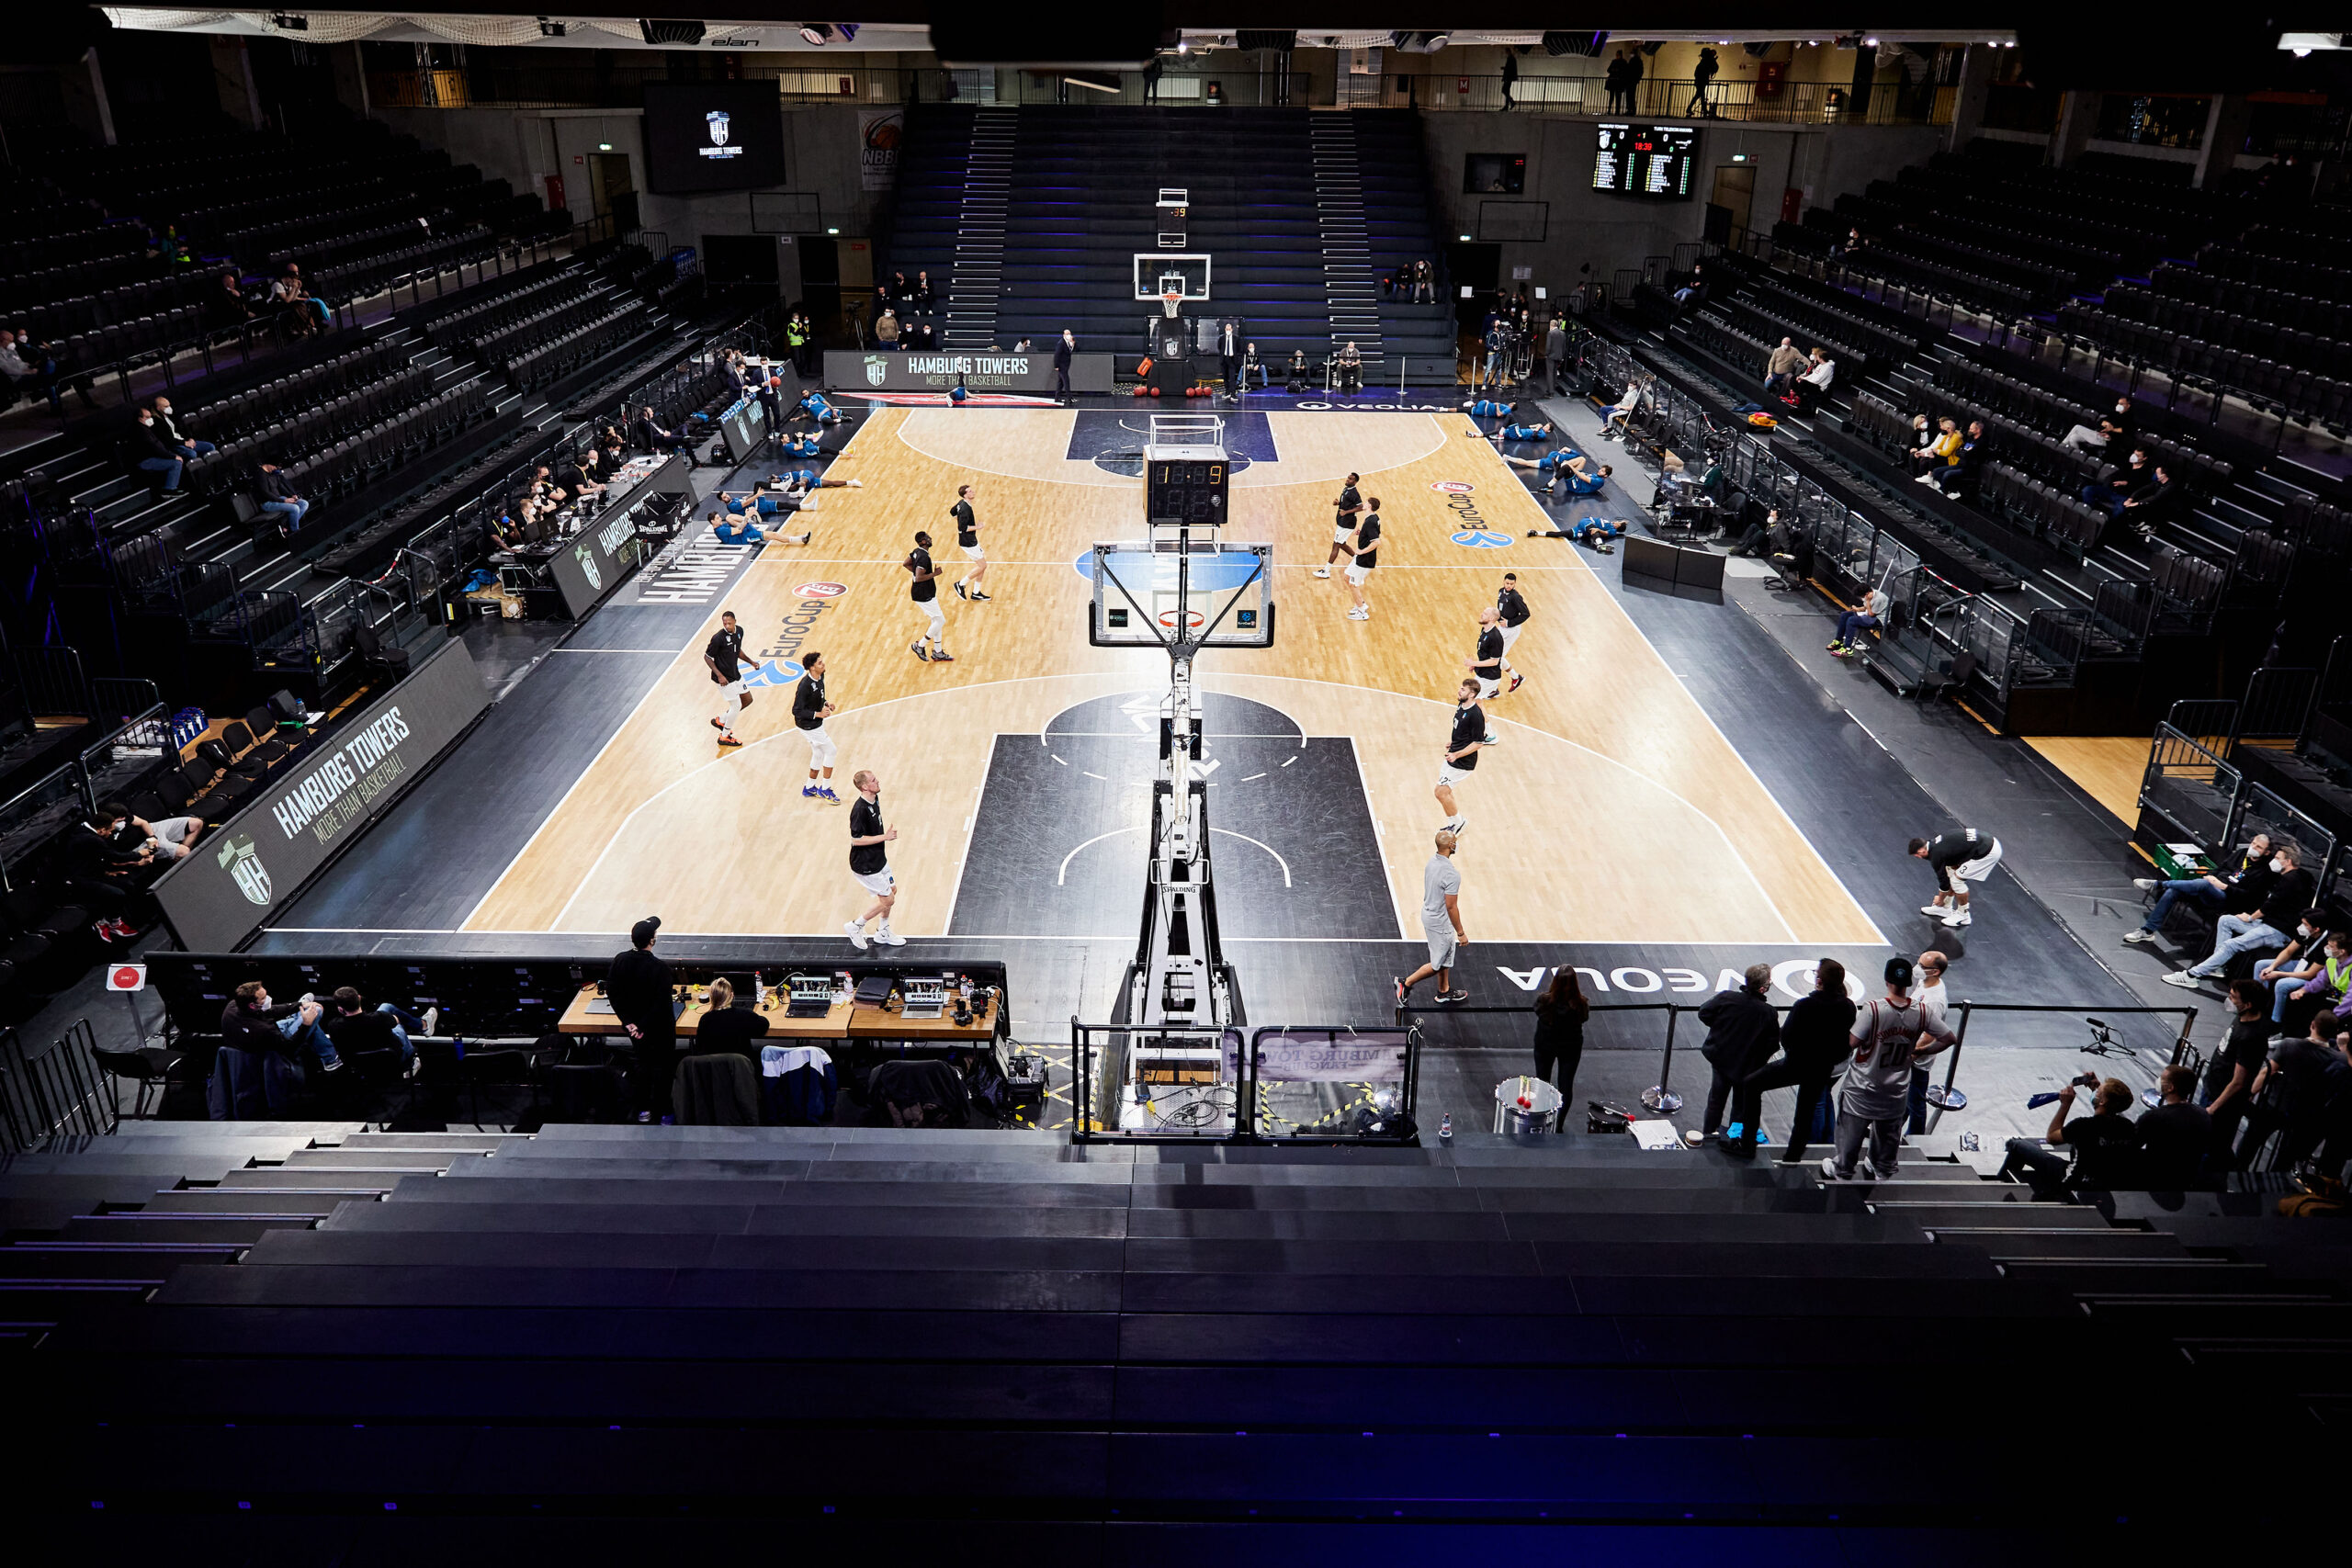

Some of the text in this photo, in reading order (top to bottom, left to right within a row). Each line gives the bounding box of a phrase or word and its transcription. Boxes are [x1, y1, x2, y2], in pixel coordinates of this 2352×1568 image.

[712, 37, 760, 47] elan
[842, 81, 849, 91] L
[1459, 80, 1468, 90] M
[1619, 131, 1625, 140] 0
[1663, 133, 1669, 142] 0
[1634, 142, 1653, 151] 18:39
[863, 149, 899, 165] NBB
[976, 357, 1028, 375] TOWERS
[926, 375, 946, 386] MORE
[968, 375, 1012, 386] BASKETBALL
[1447, 493, 1488, 530] EuroCup
[598, 511, 637, 557] HAMBURG
[639, 525, 668, 533] SPALDING
[759, 600, 832, 658] EuroCup
[272, 705, 411, 840] HAMBURG TOWERS
[311, 753, 407, 845] MORE THAN BASKETBALL
[1959, 865, 1967, 874] 3
